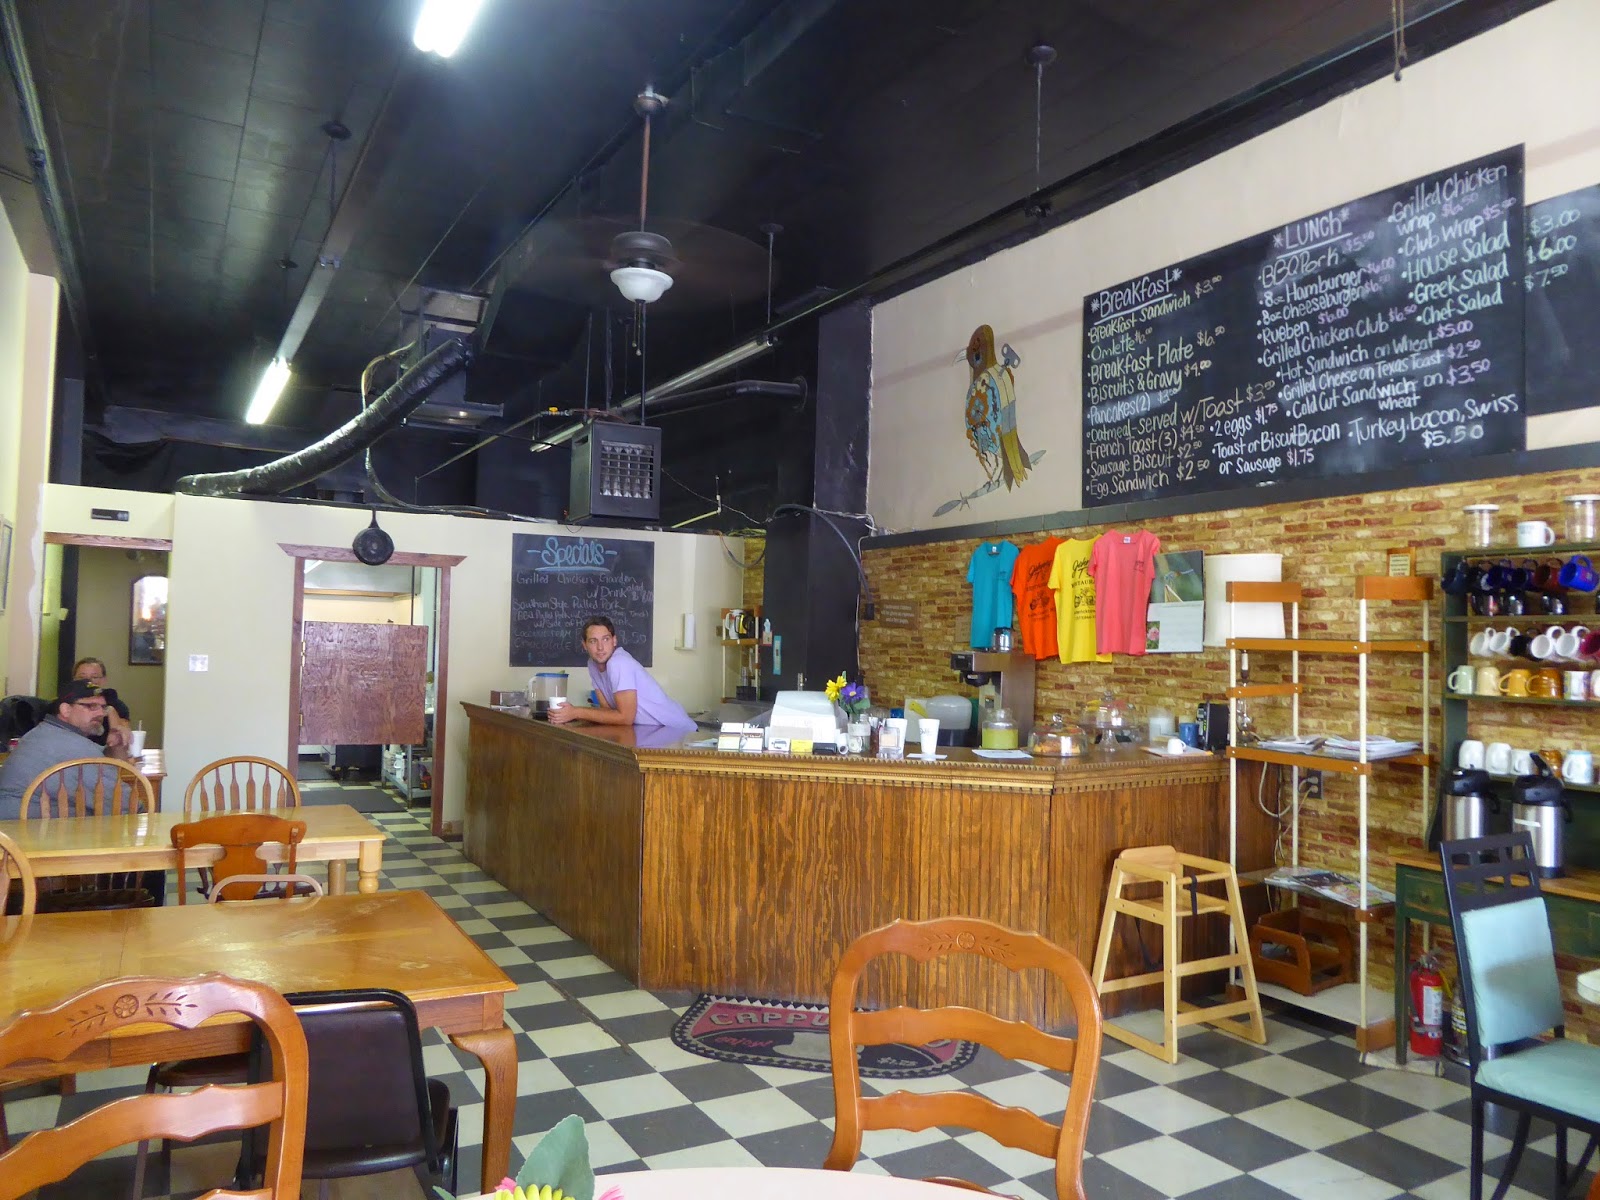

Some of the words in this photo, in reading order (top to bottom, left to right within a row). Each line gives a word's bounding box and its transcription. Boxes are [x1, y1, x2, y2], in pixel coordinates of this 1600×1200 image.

[1392, 182, 1441, 222] Grilled
[1443, 165, 1508, 200] Chicken
[1461, 220, 1511, 262] Salad
[1530, 209, 1580, 238] $3.00
[1405, 229, 1439, 256] Club
[1262, 255, 1300, 288] BBQ
[1300, 247, 1339, 273] Pork
[1286, 268, 1366, 303] Hamburger
[1461, 252, 1509, 290] Salad
[1099, 268, 1172, 318] Breakfast
[1422, 298, 1455, 325] Chef
[1457, 282, 1503, 315] Salad
[1090, 312, 1137, 344] Breakfast
[1263, 321, 1309, 345] Rueben
[1318, 307, 1349, 324] $6.00
[1263, 338, 1301, 367] Grilled
[1301, 327, 1355, 352] Chicken
[1356, 313, 1389, 338] Club
[1091, 333, 1135, 360] Omlette
[1091, 347, 1154, 385] Breakfast
[1158, 336, 1194, 368] Plate
[1281, 360, 1303, 382] Hot
[1305, 344, 1368, 375] Sandwich
[1374, 346, 1391, 359] on
[1437, 320, 1474, 338] $5.00
[1091, 374, 1134, 405] Biscuits
[1137, 372, 1145, 392] &
[1146, 368, 1182, 393] Gravy
[1283, 375, 1317, 401] Grilled
[1319, 369, 1358, 390] Cheese
[1359, 366, 1375, 381] on
[1376, 358, 1409, 378] Texas
[1410, 350, 1445, 370] Toast
[1292, 394, 1317, 419] Cold
[1319, 389, 1340, 411] Cut
[1342, 377, 1418, 406] Sandwich
[1423, 373, 1443, 387] on
[1465, 393, 1518, 419] Swiss
[1215, 420, 1222, 436] 2
[1224, 415, 1252, 440] eggs
[1255, 403, 1278, 425] $1.75
[1421, 425, 1484, 449] $5.50
[1090, 438, 1125, 461] French
[1126, 433, 1157, 455] Toast
[1158, 428, 1178, 452] (3)
[1214, 437, 1246, 458] Toast
[1248, 440, 1260, 454] or
[1260, 425, 1298, 452] Biscuit
[1298, 423, 1340, 447] Bacon
[1091, 459, 1130, 478] Sausage
[1133, 450, 1174, 471] Biscuit
[1091, 479, 1109, 499] Egg
[1111, 470, 1169, 494] Sandwich
[1176, 459, 1210, 481] $2.50
[1219, 461, 1233, 475] or
[1236, 456, 1282, 474] Sausage
[1287, 447, 1315, 467] $1.75
[517, 572, 549, 584] Grilled
